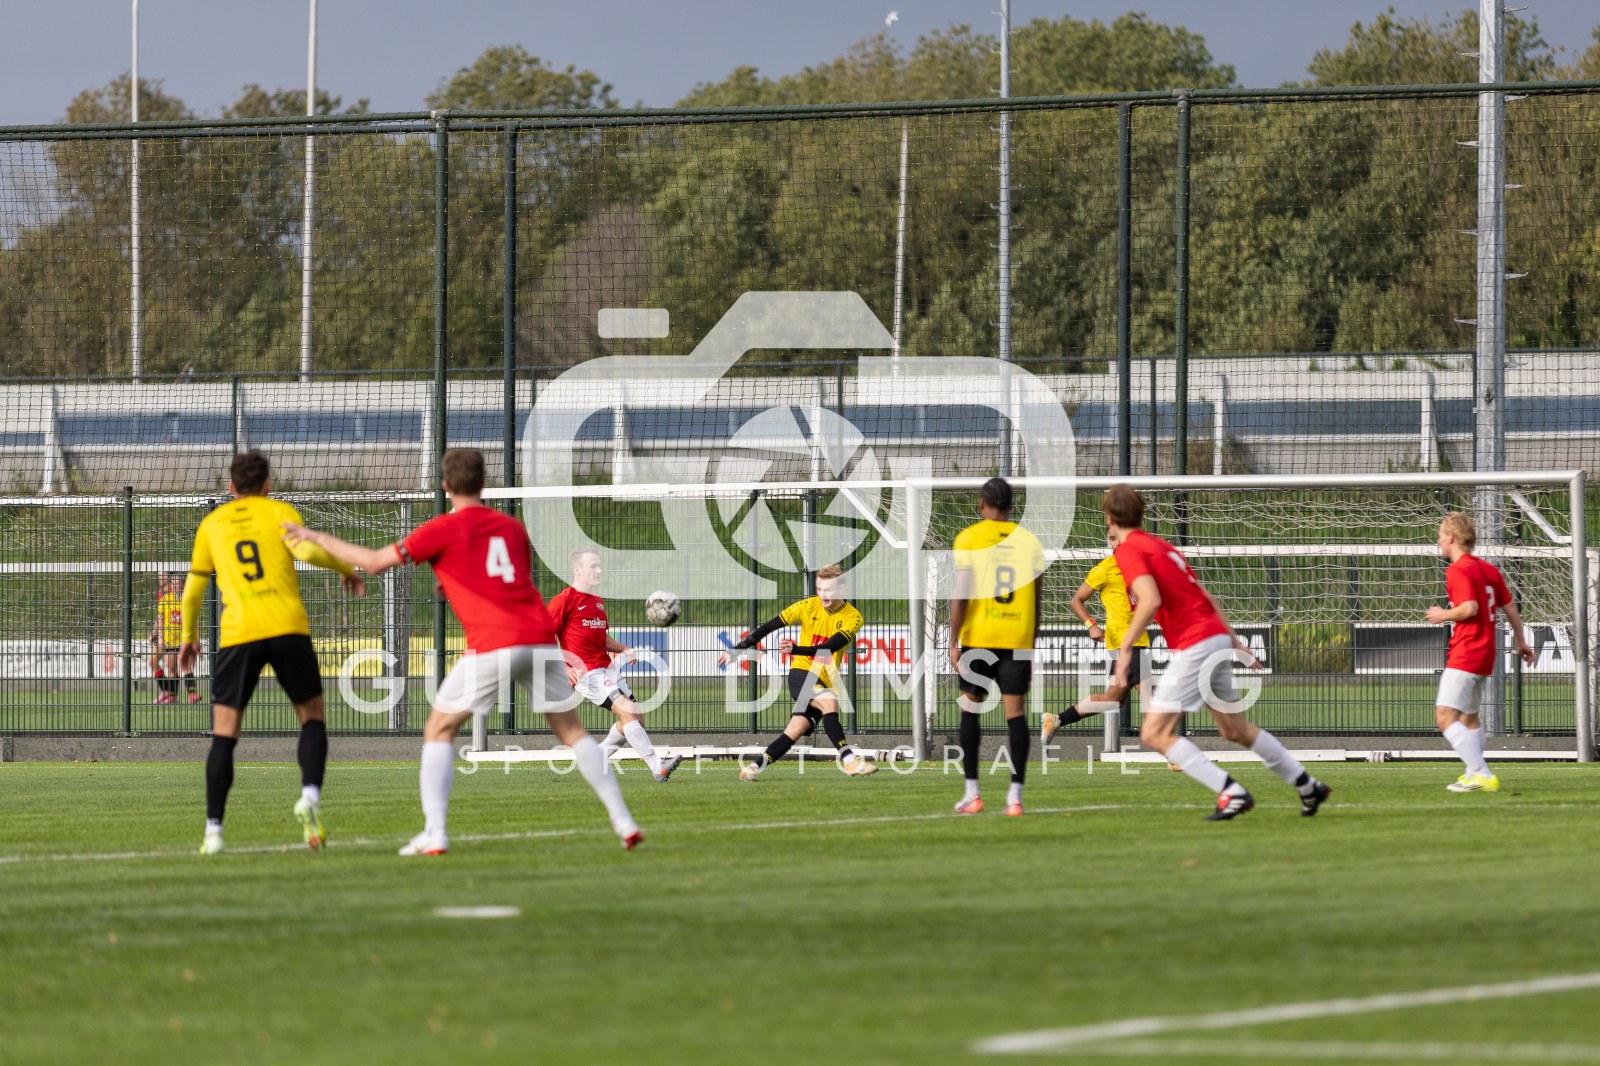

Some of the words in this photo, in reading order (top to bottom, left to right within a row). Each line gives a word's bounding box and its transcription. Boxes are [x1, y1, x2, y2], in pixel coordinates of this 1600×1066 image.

[235, 540, 264, 582] 9
[486, 536, 516, 584] 4
[994, 566, 1015, 604] 8
